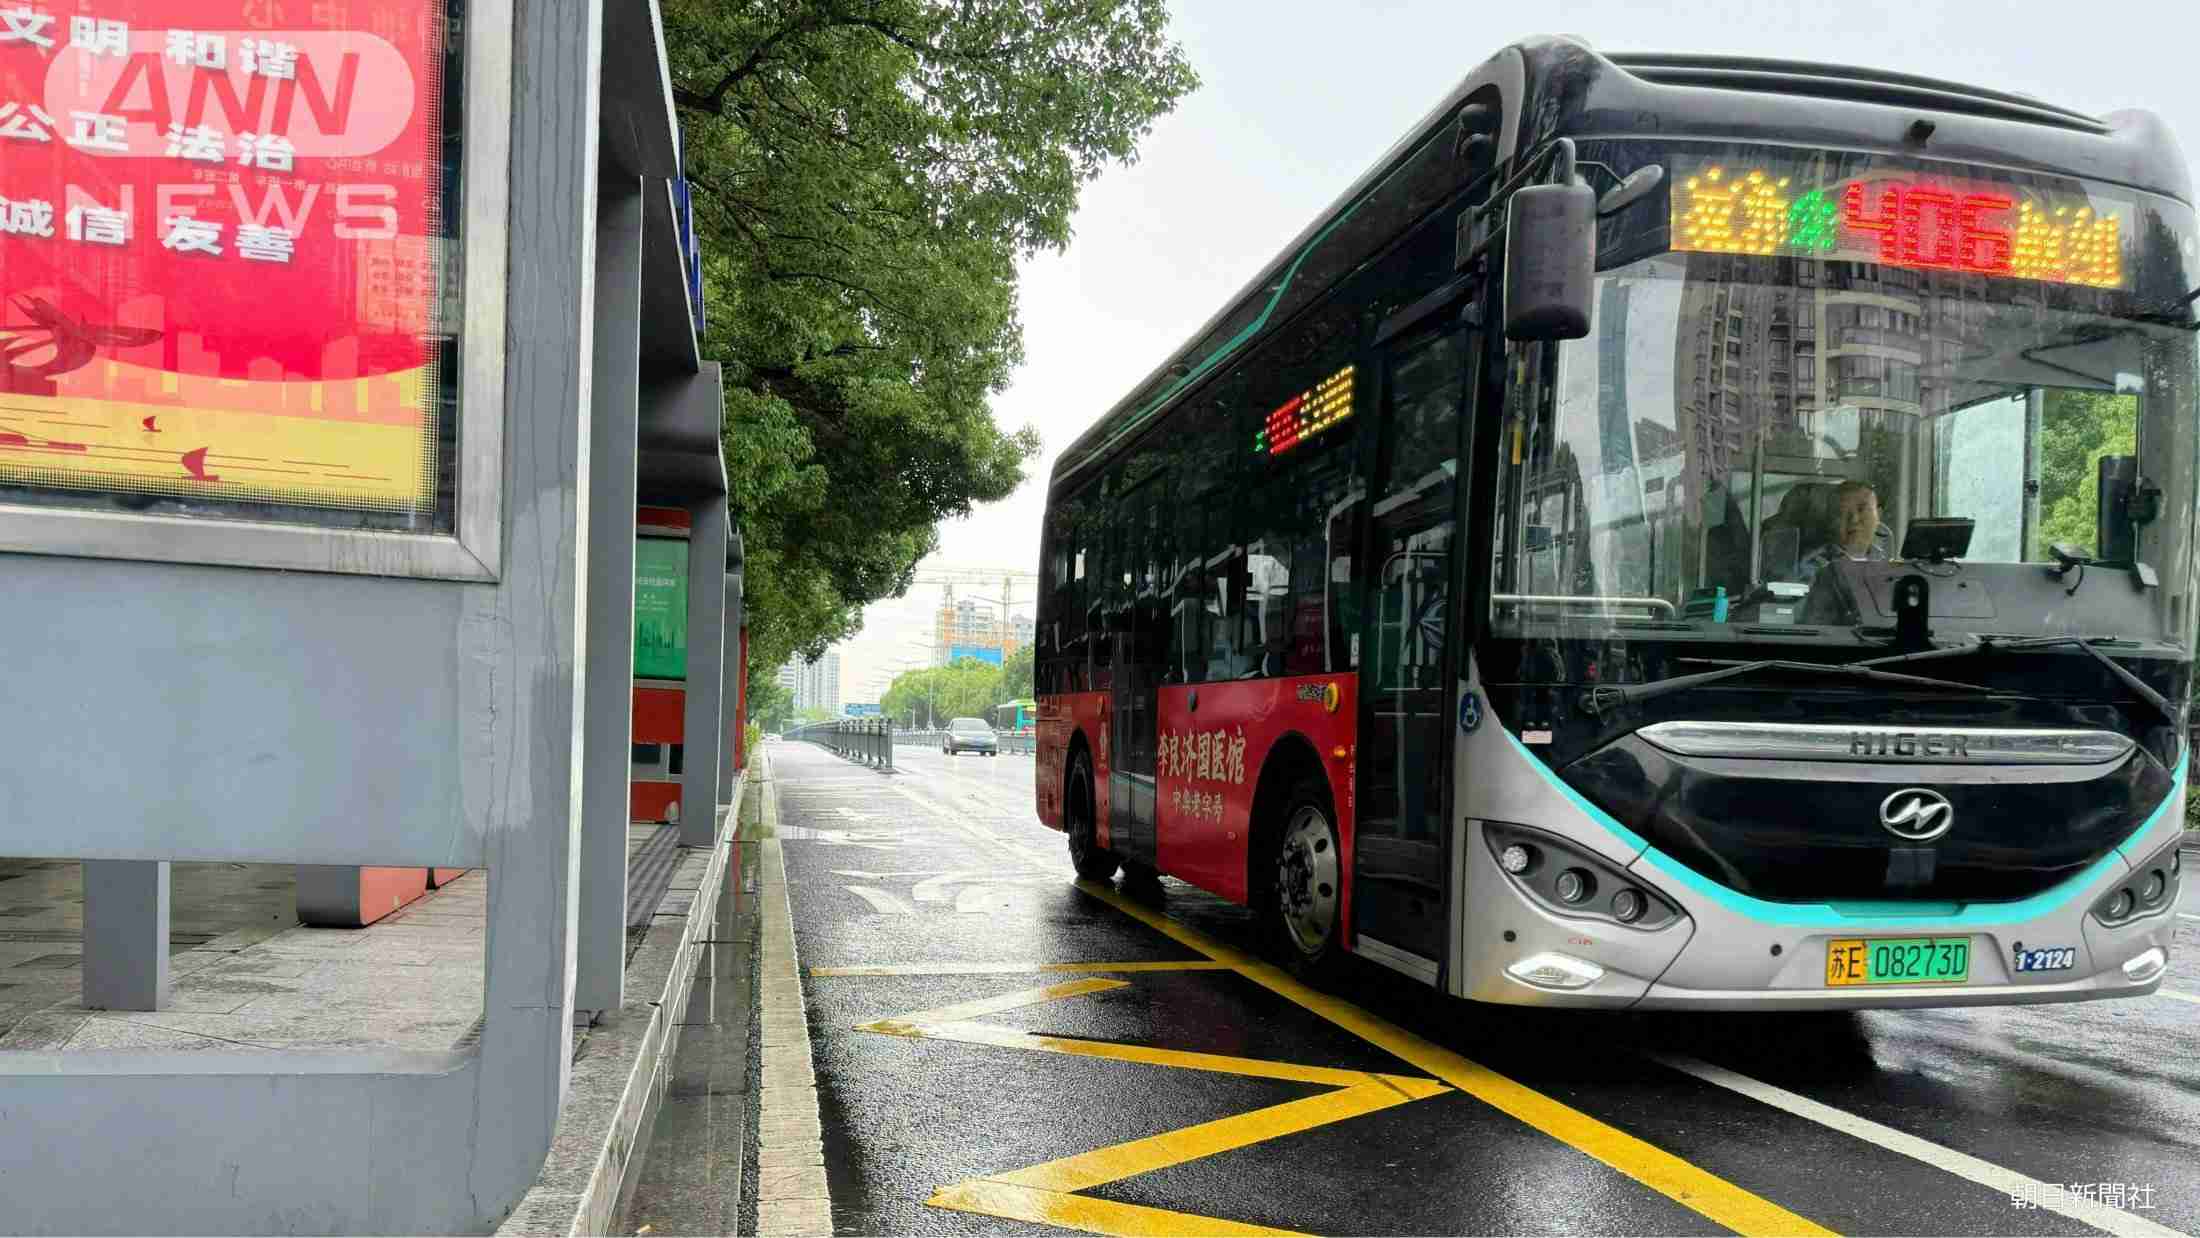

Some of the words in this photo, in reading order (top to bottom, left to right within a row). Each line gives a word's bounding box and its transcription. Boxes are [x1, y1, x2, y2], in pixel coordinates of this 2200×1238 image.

[0, 7, 128, 57] 文明
[166, 28, 299, 80] 和谐
[0, 101, 129, 151] 公正
[164, 121, 296, 172] 法治
[0, 194, 129, 245] 诚信
[162, 214, 295, 263] 友善
[1845, 178, 2014, 275] 406
[1850, 731, 1968, 757] HIGER
